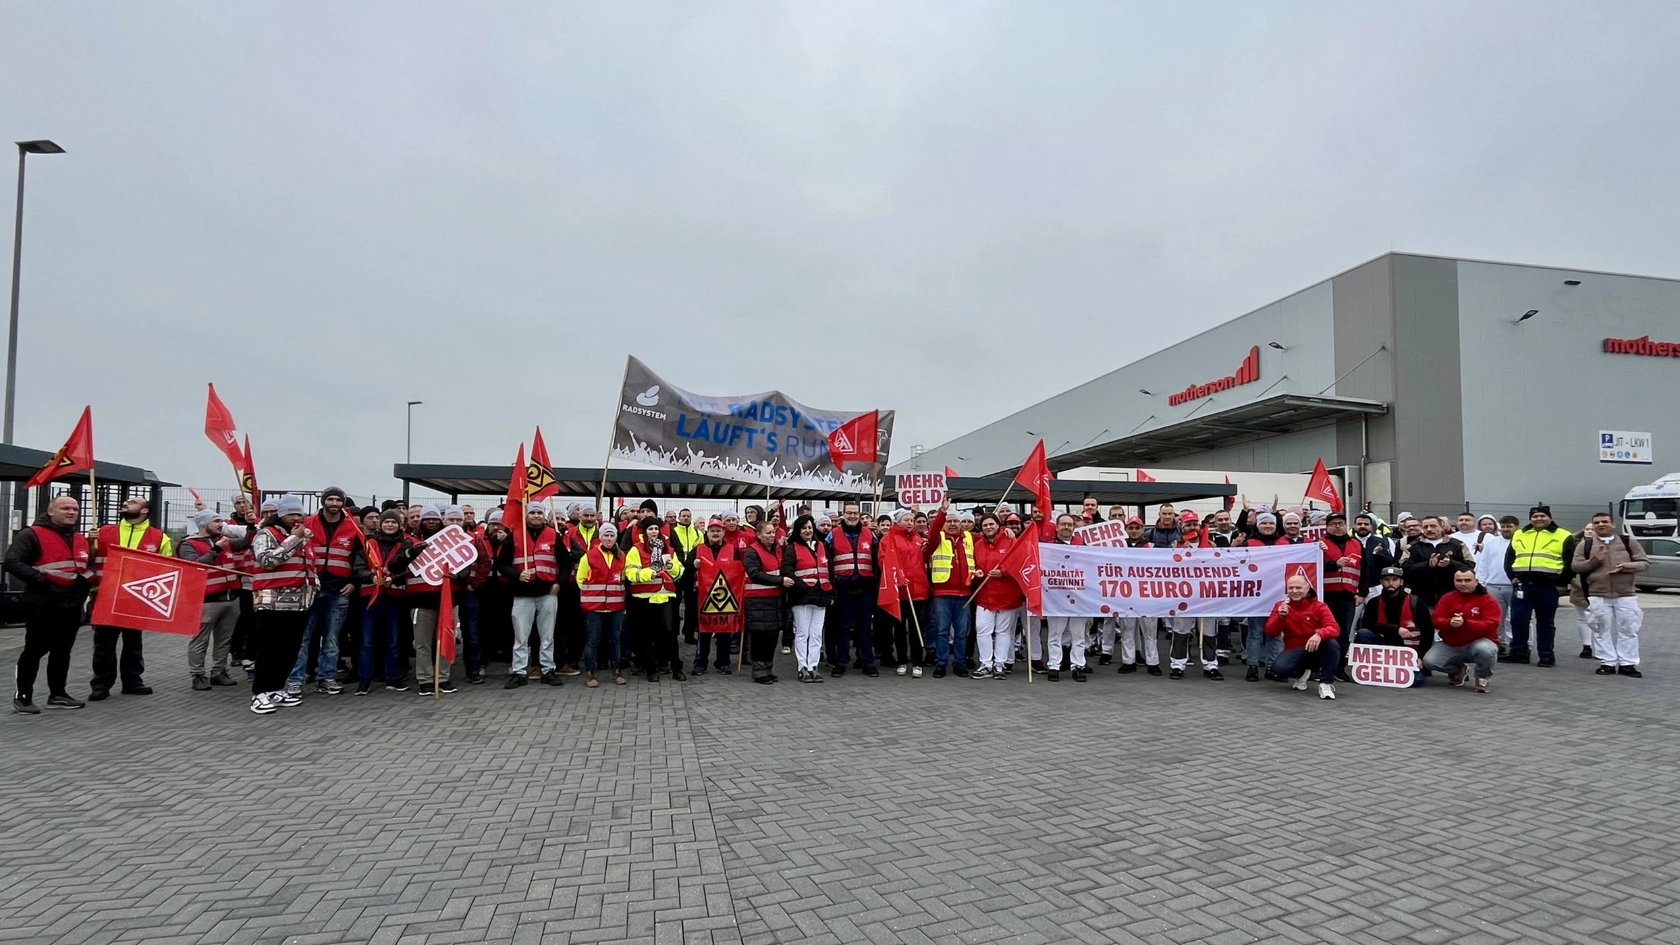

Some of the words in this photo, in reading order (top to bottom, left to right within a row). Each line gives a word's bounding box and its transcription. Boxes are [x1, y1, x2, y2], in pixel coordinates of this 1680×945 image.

[1168, 376, 1234, 406] motherson
[622, 404, 667, 421] RADSYSTEM
[898, 474, 944, 488] MEHR
[901, 489, 941, 504] GELD
[1074, 522, 1124, 544] MEHR
[411, 527, 467, 571] MEHR
[1039, 569, 1084, 578] OLIDARITÄT
[1097, 563, 1123, 578] FÜR
[1127, 566, 1240, 578] AUSZUBILDENDE
[1047, 578, 1085, 586] GEWINNT
[1098, 580, 1132, 598] 170
[1138, 580, 1193, 598] EURO
[1199, 580, 1262, 598] MEHR!
[1352, 647, 1414, 667] MEHR
[1356, 665, 1410, 685] GELD
